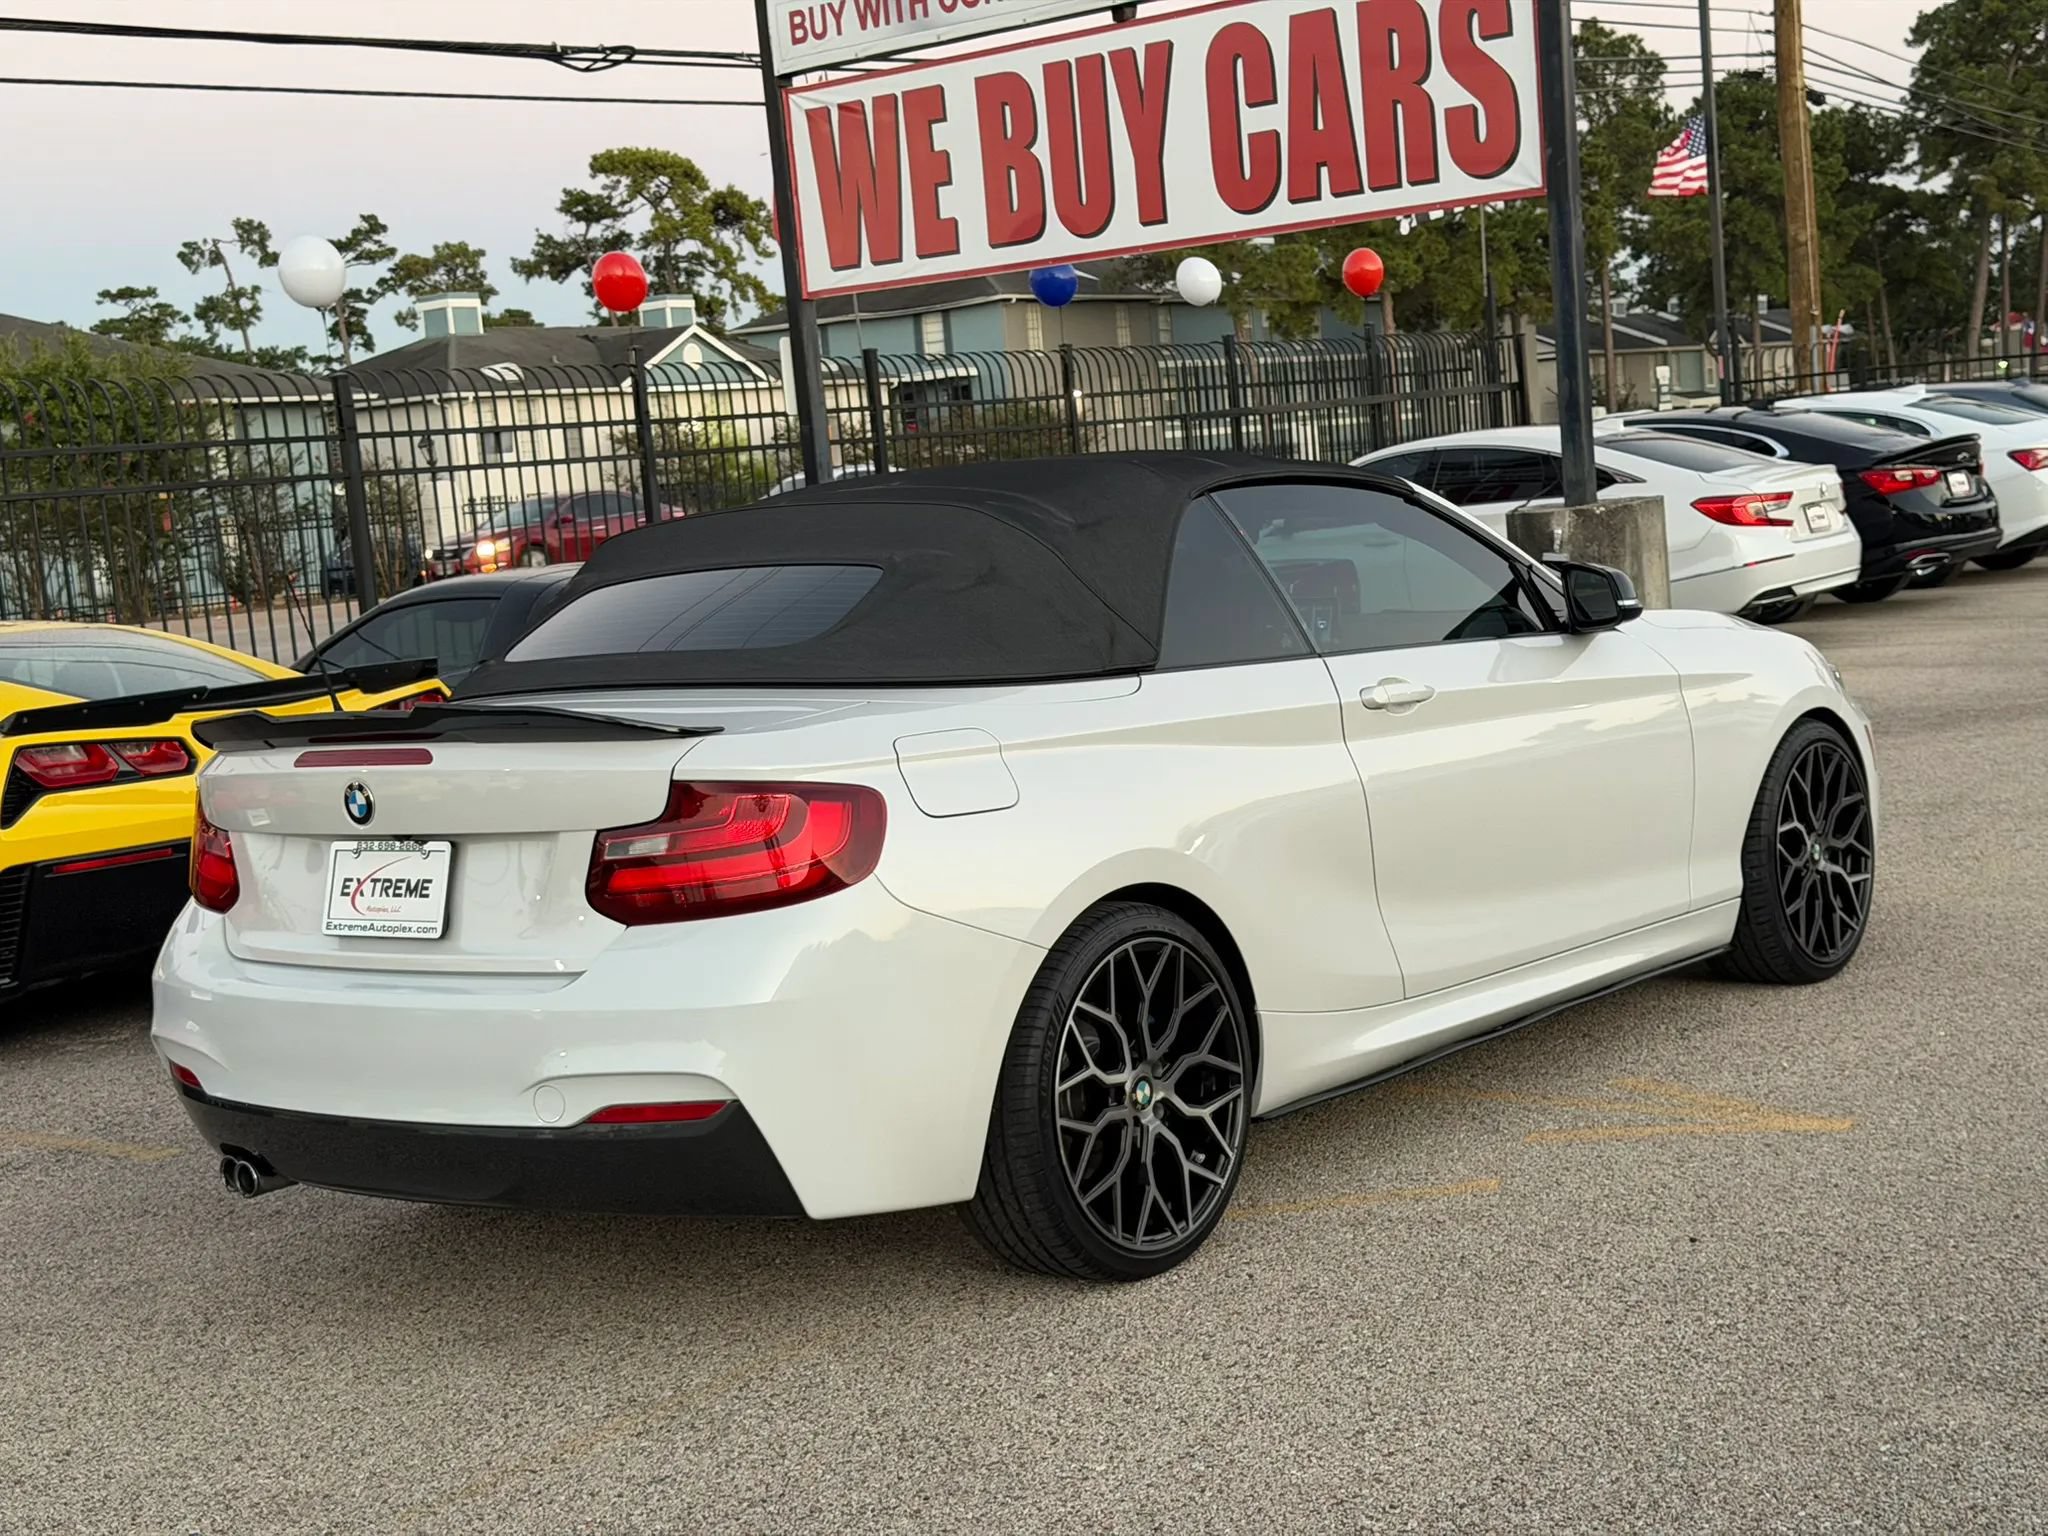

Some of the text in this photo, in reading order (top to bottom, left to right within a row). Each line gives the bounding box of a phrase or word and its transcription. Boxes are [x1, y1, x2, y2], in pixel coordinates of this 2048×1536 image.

[788, 0, 847, 46] BUY
[805, 0, 1522, 272] WE BUY CARS
[340, 877, 434, 899] EXTREME
[325, 921, 438, 935] ExtremeAutoplex.com
